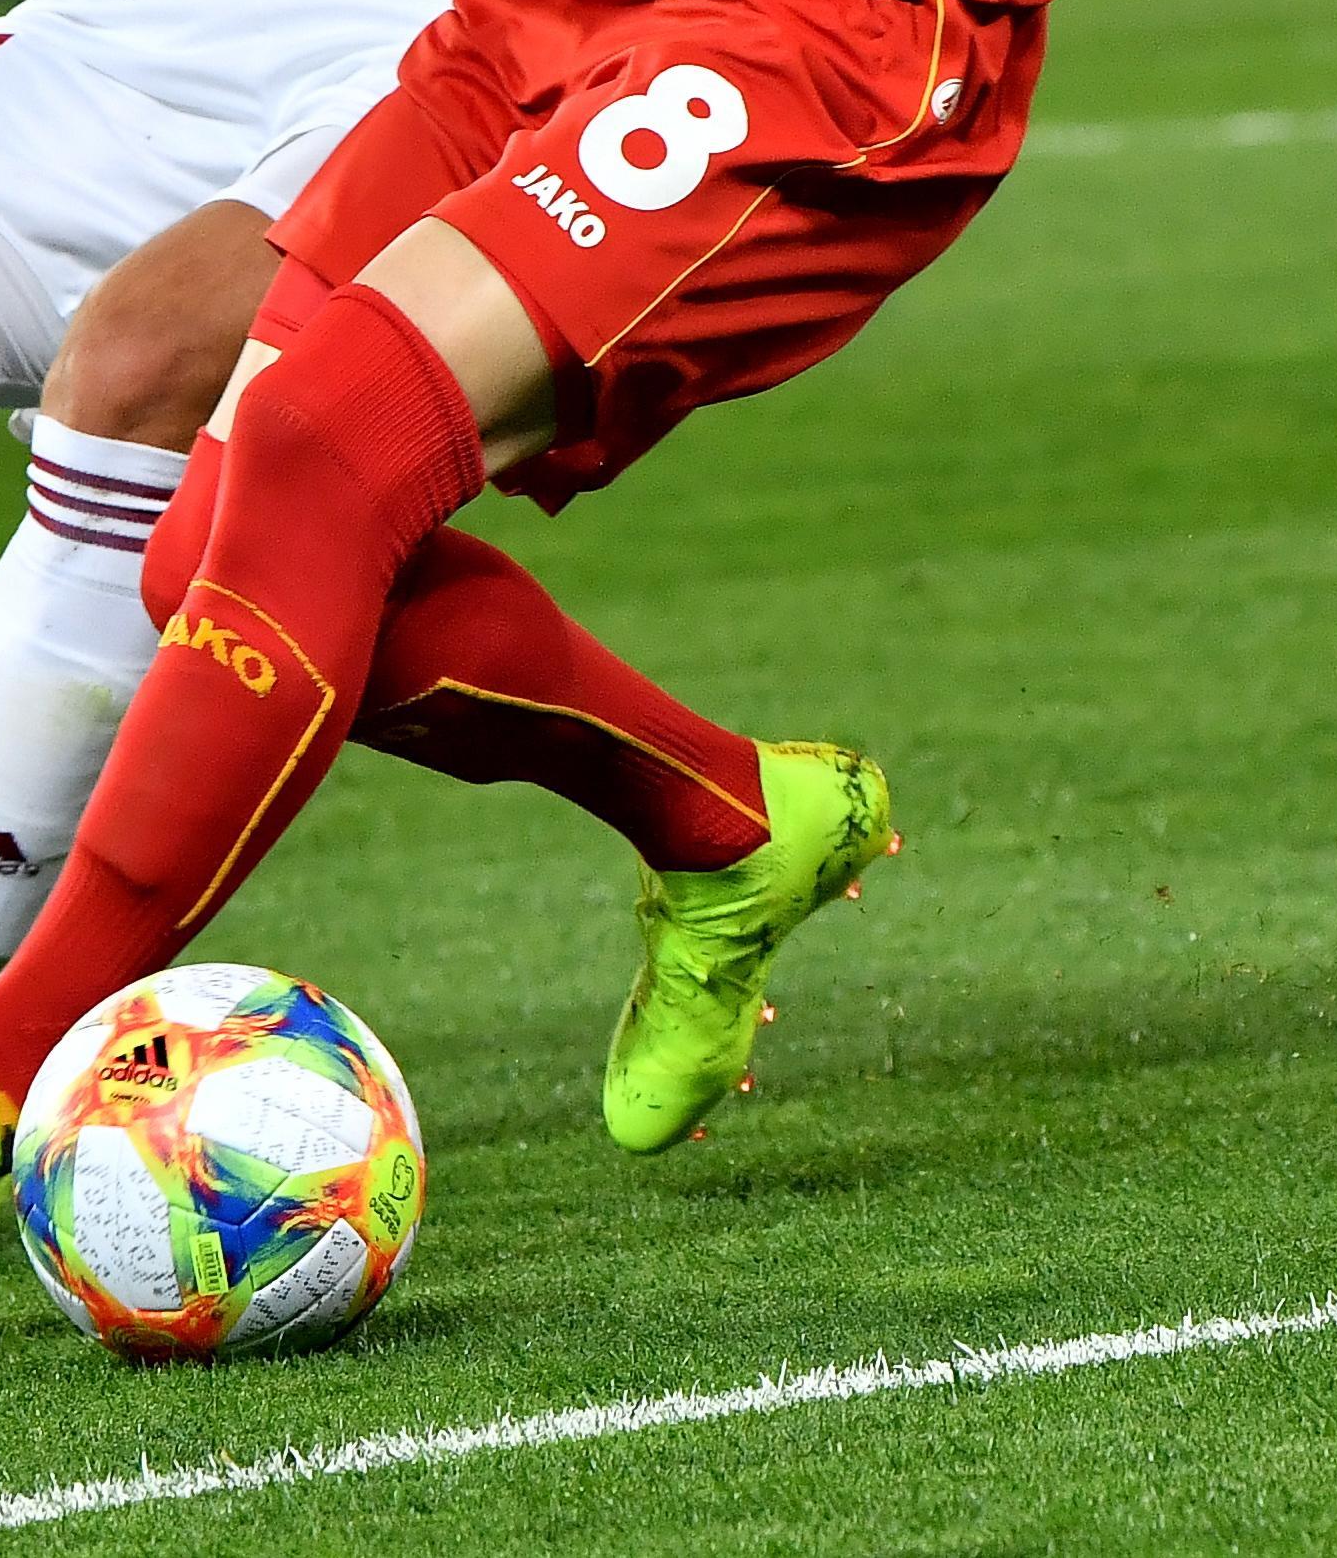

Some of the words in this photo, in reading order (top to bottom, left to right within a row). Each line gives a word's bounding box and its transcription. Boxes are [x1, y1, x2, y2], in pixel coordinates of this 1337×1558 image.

[578, 64, 749, 211] 8
[512, 163, 607, 248] JAKO
[158, 614, 278, 697] AKO
[100, 1062, 178, 1091] adidas
